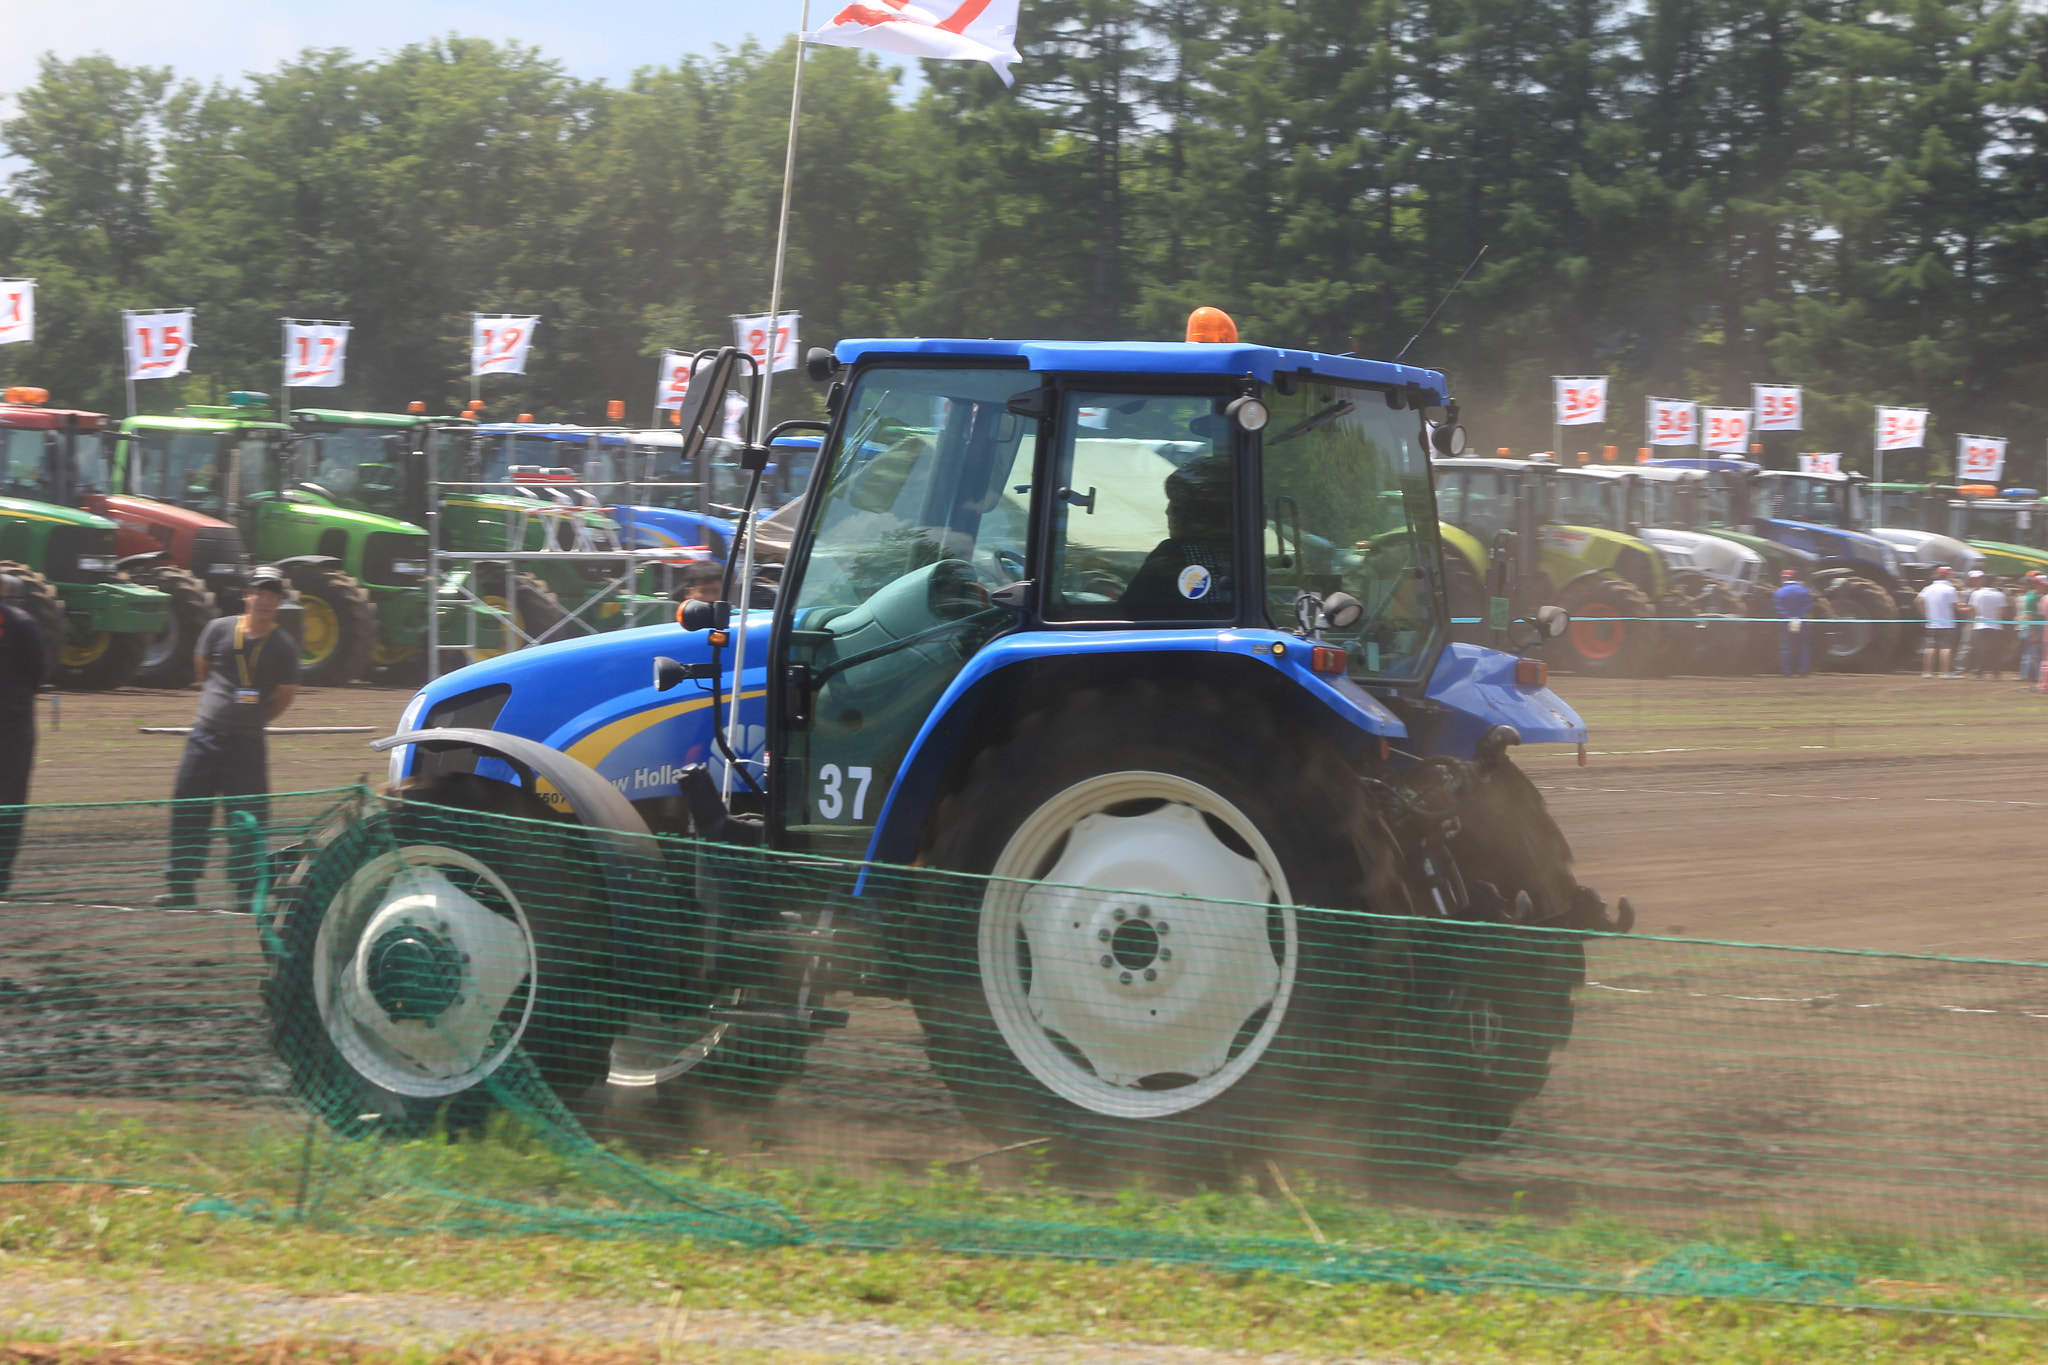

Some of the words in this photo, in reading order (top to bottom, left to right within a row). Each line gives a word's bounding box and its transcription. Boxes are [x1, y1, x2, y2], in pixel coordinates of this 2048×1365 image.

[136, 326, 185, 358] 15
[295, 337, 340, 366] 17
[481, 328, 523, 355] 19
[1563, 388, 1603, 410] 36
[1761, 396, 1798, 416] 35
[1656, 410, 1693, 431] 32
[1706, 418, 1747, 438] 30
[1965, 446, 2000, 466] 29
[634, 762, 707, 790] Holla
[818, 763, 873, 820] 37
